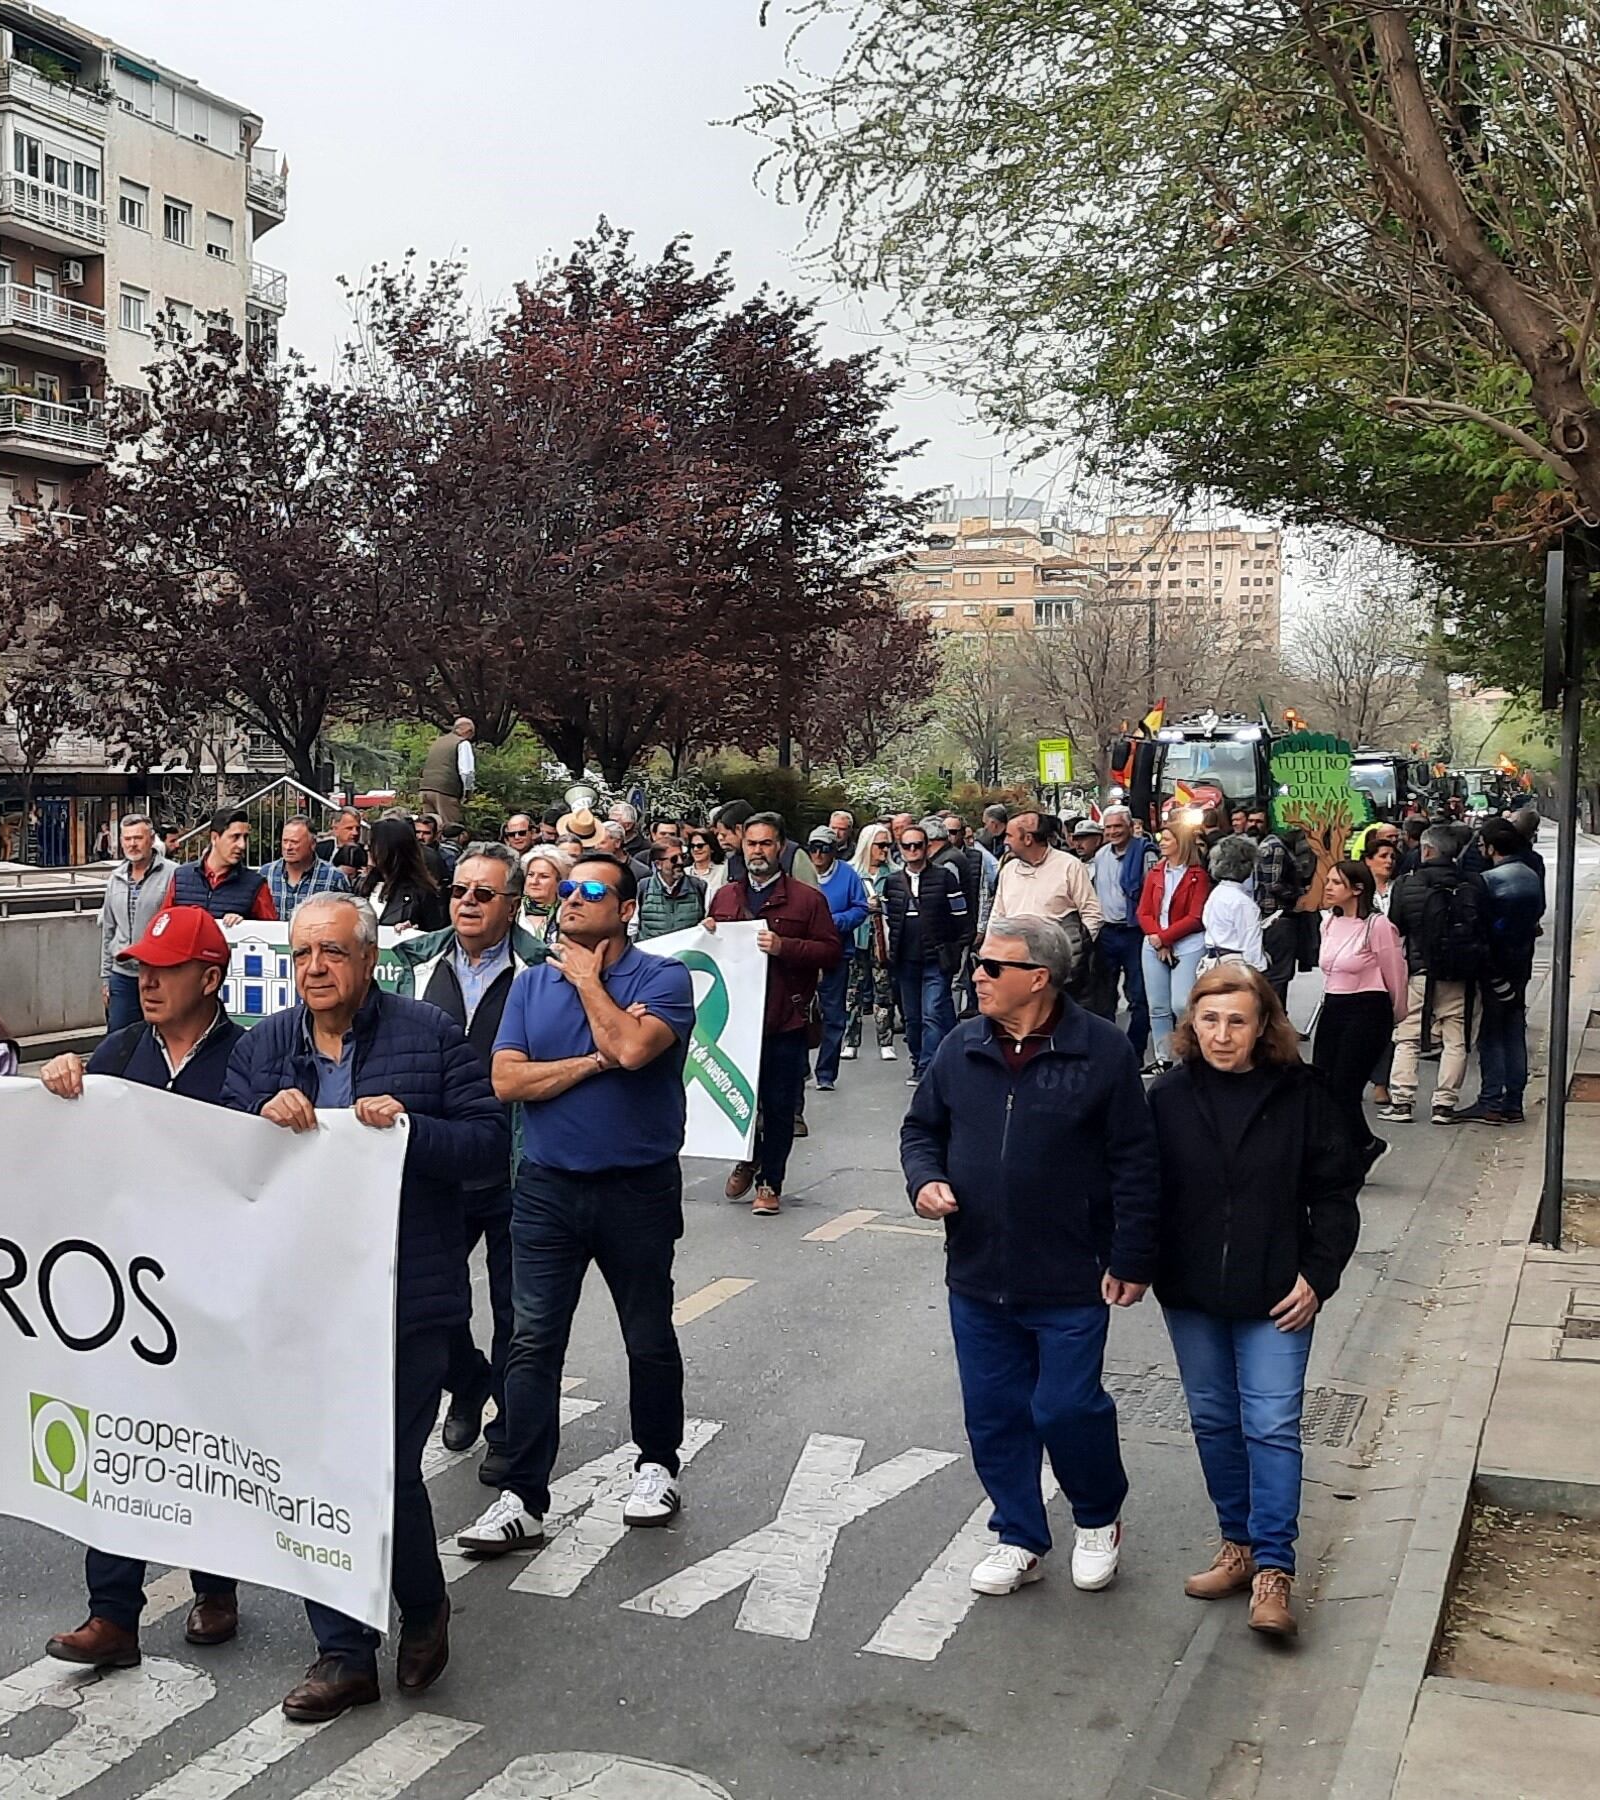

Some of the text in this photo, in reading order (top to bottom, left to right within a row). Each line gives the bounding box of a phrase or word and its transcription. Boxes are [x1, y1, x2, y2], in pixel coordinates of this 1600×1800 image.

[1287, 784, 1352, 800] OLIVAR
[1296, 770, 1327, 785] DEL
[692, 1045, 709, 1064] de
[701, 1056, 733, 1093] nuestro
[725, 1087, 750, 1120] campo
[95, 1413, 282, 1484] cooperativas
[94, 1448, 351, 1535] agro-alimentarias
[276, 1531, 352, 1571] Granada
